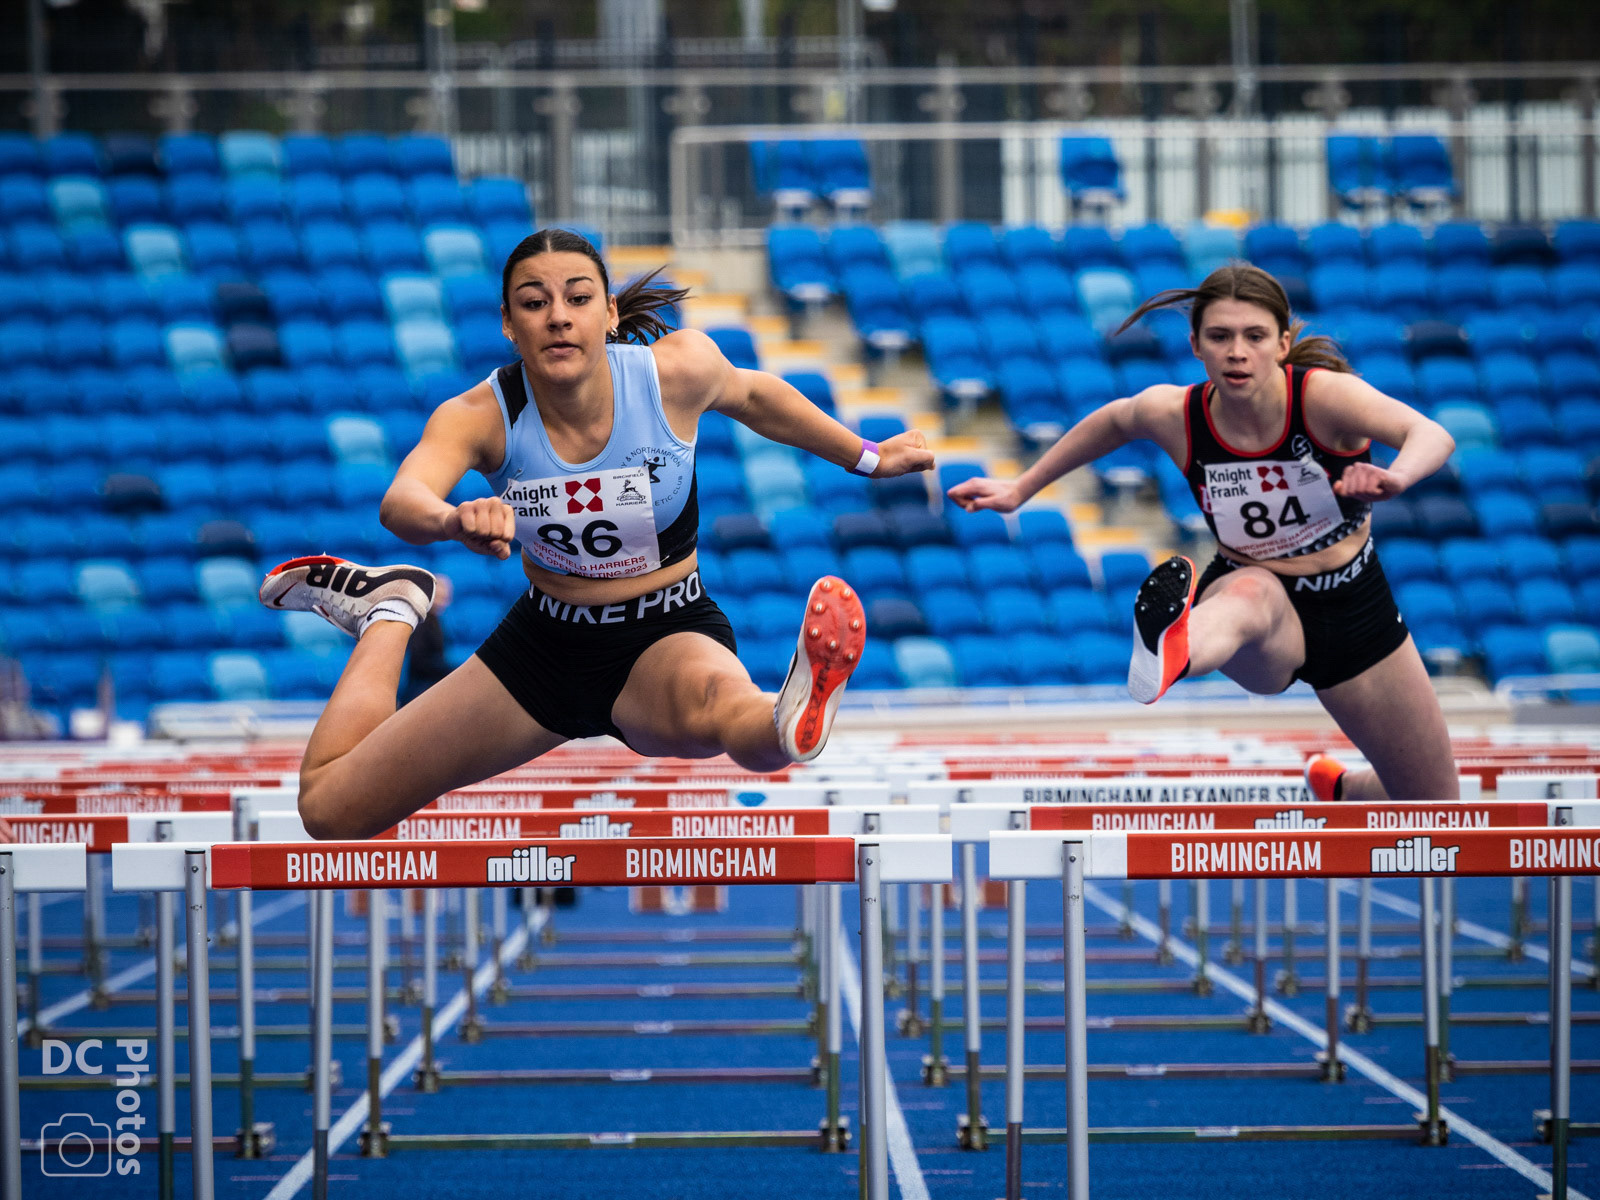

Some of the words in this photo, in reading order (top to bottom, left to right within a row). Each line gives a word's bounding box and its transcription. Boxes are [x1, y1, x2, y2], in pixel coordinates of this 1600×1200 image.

[631, 446, 681, 468] NORTHAMPTON
[654, 494, 673, 507] ETIC
[673, 475, 683, 495] CLUB
[1208, 468, 1253, 485] Knight
[1210, 484, 1249, 499] Frank
[512, 502, 552, 517] rank
[1240, 495, 1312, 539] 84
[537, 519, 623, 558] 86
[533, 540, 587, 572] BIRCHFIELD
[590, 555, 646, 571] HARRIERS
[546, 555, 572, 573] OPEN
[624, 562, 648, 574] 2023
[1295, 555, 1363, 592] NIKE
[539, 594, 626, 624] NIKE
[636, 571, 701, 619] PRO
[1022, 787, 1152, 803] BIRMINGHAM
[1160, 786, 1271, 803] ALEXANDER
[1276, 785, 1313, 802] STA
[397, 817, 520, 840] BIRMINGHAM
[559, 814, 634, 839] müller
[671, 816, 795, 837] BIRMINGHAM
[1092, 812, 1215, 830] BIRMINGHAM
[1254, 809, 1328, 830] müller
[1367, 811, 1490, 829] BIRMINGHAM
[287, 850, 437, 882] BIRMINGHAM
[486, 845, 577, 883] müller
[626, 846, 777, 878] BIRMINGHAM
[1171, 841, 1321, 872] BIRMINGHAM
[1369, 836, 1460, 873] müller
